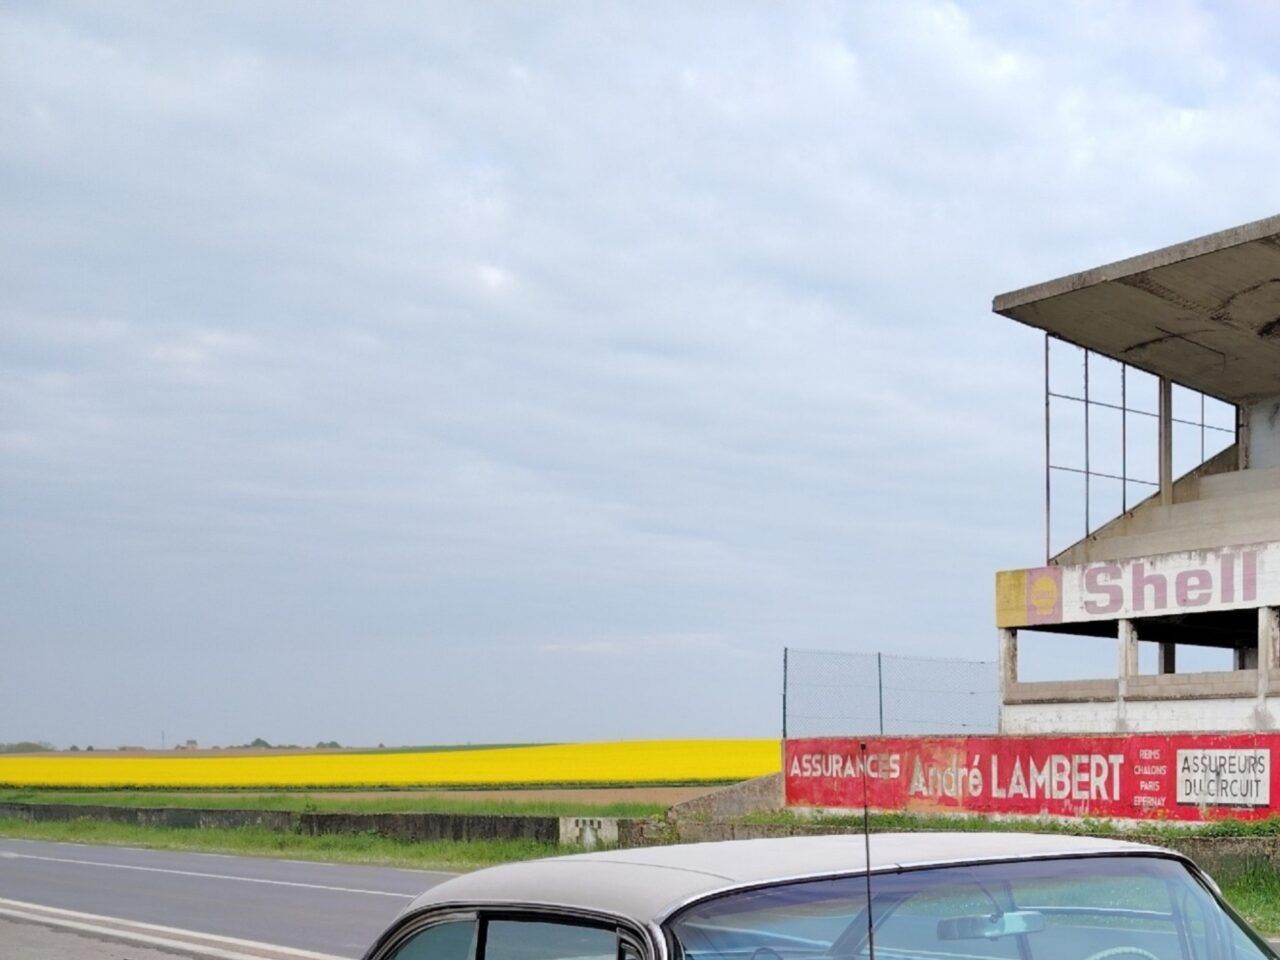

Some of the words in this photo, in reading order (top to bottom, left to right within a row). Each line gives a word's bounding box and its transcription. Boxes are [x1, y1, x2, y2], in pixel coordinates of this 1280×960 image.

[1082, 550, 1258, 616] Shell
[1139, 749, 1160, 760] REIMS
[1133, 765, 1167, 776] CHALONS
[1182, 755, 1265, 775] ASSUREURS
[790, 753, 900, 780] ASSURANCES
[910, 753, 983, 798] André
[991, 753, 1124, 801] LAMBERT
[1139, 780, 1160, 791] PARIS
[1184, 778, 1202, 797] DU
[1207, 779, 1261, 798] CIRCUIT
